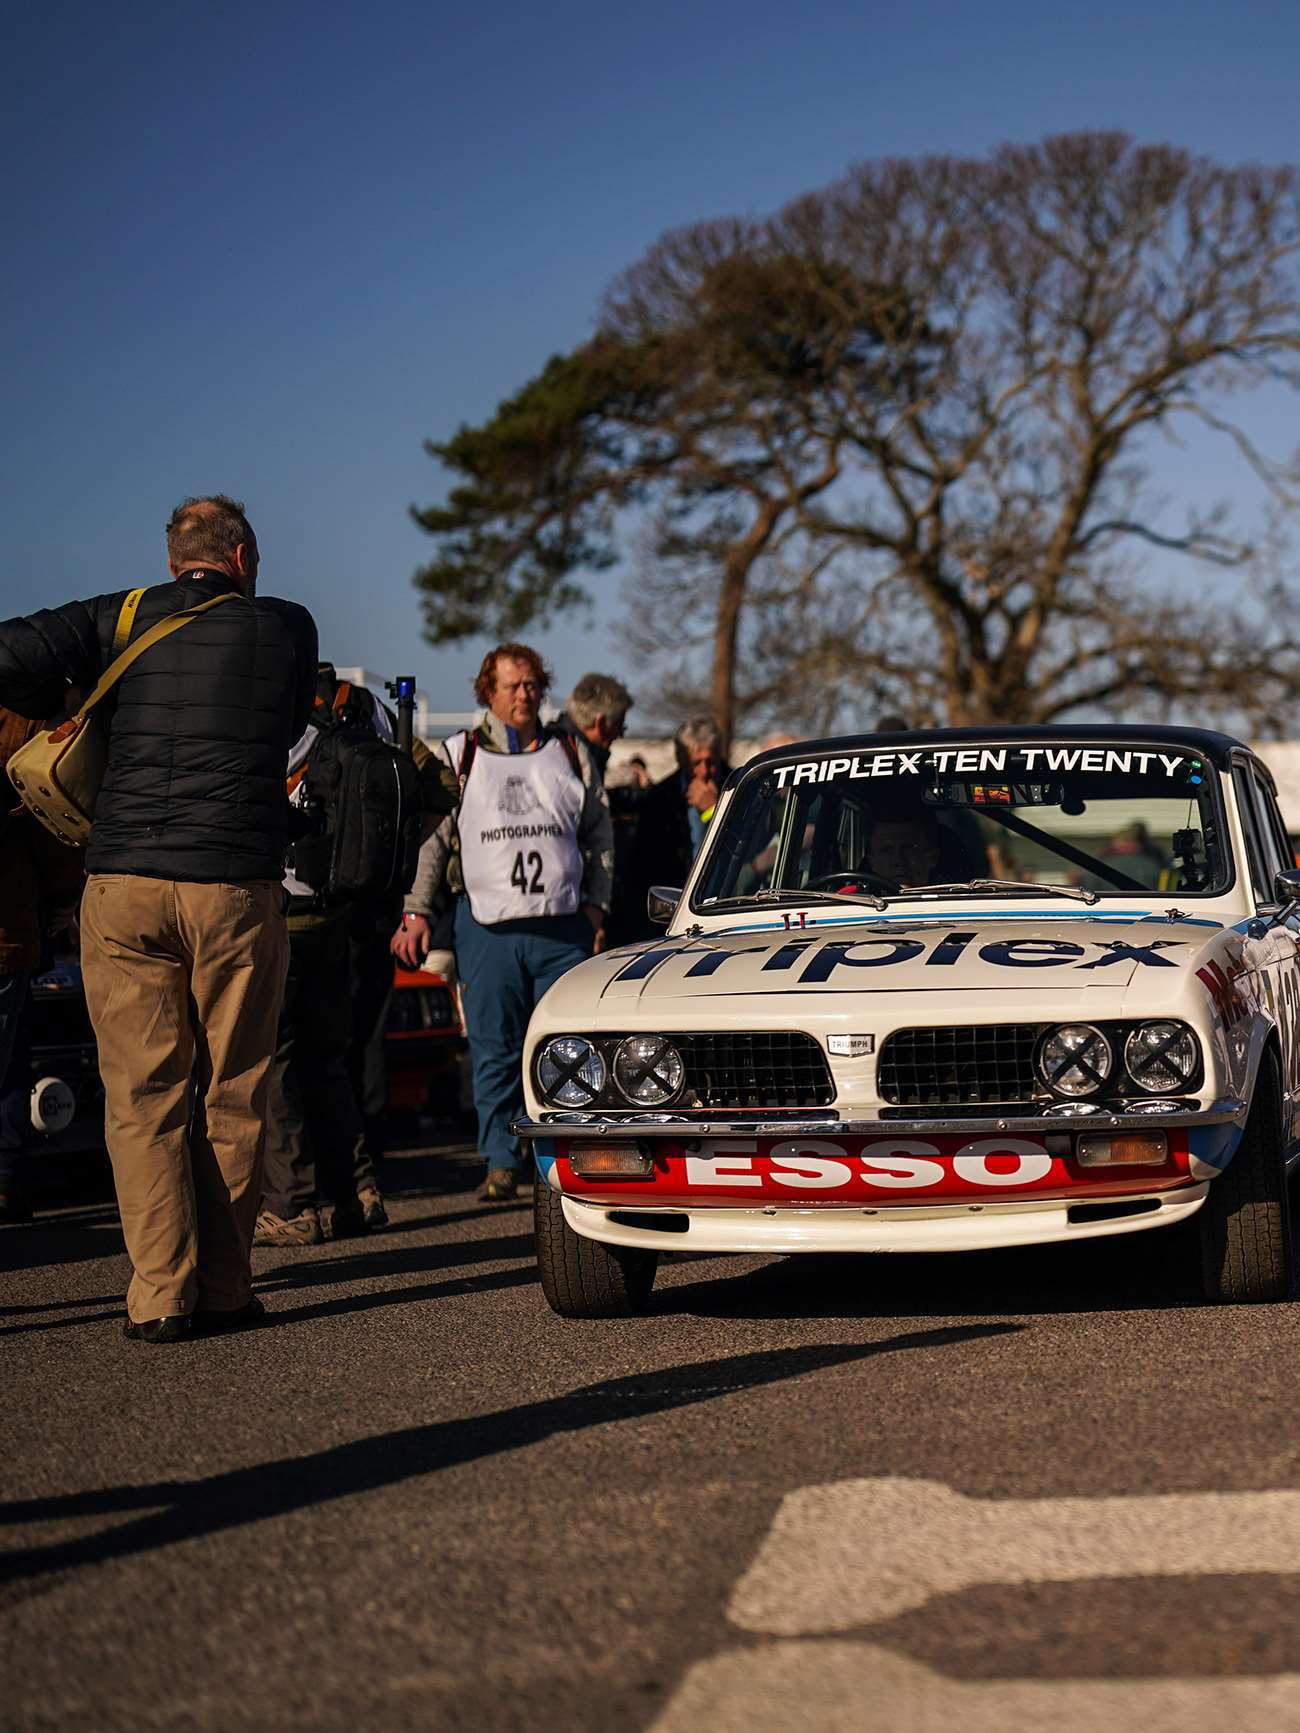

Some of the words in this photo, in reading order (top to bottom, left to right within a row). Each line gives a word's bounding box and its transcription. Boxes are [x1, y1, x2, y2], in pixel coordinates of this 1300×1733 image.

[773, 752, 923, 790] TRIPLEX
[934, 750, 1007, 774] TEN
[1020, 749, 1185, 777] TWENTY
[510, 850, 545, 894] 42
[604, 932, 1190, 984] Triplex
[832, 1040, 868, 1048] TRIUMPH
[685, 1138, 1053, 1189] ESSO
